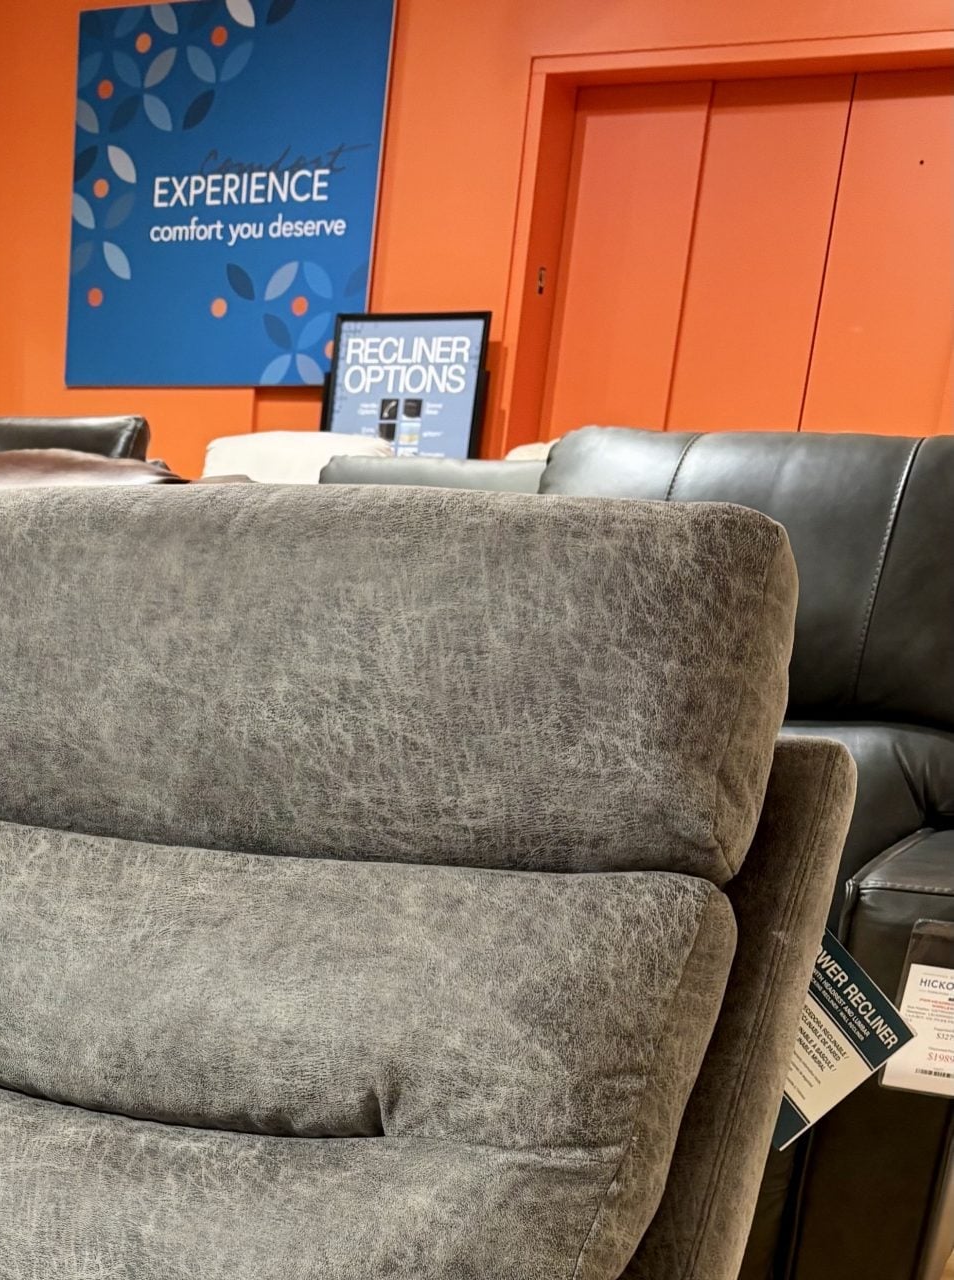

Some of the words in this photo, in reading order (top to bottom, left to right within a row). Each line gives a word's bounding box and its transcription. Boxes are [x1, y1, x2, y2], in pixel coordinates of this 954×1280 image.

[153, 168, 330, 208] EXPERIENCE
[150, 216, 223, 242] comfort
[228, 222, 263, 246] you
[268, 213, 346, 239] deserve
[346, 336, 471, 364] RECLINER
[344, 364, 466, 393] OPTIONS
[814, 946, 849, 988] WER
[842, 983, 899, 1049] RECLINER
[822, 979, 845, 1006] HEADREST
[842, 1005, 853, 1017] AND
[852, 1016, 870, 1036] LUMBAR
[821, 1027, 846, 1056] RECLINABLE
[826, 1044, 840, 1061] PARED
[815, 1047, 834, 1069] BASCULE
